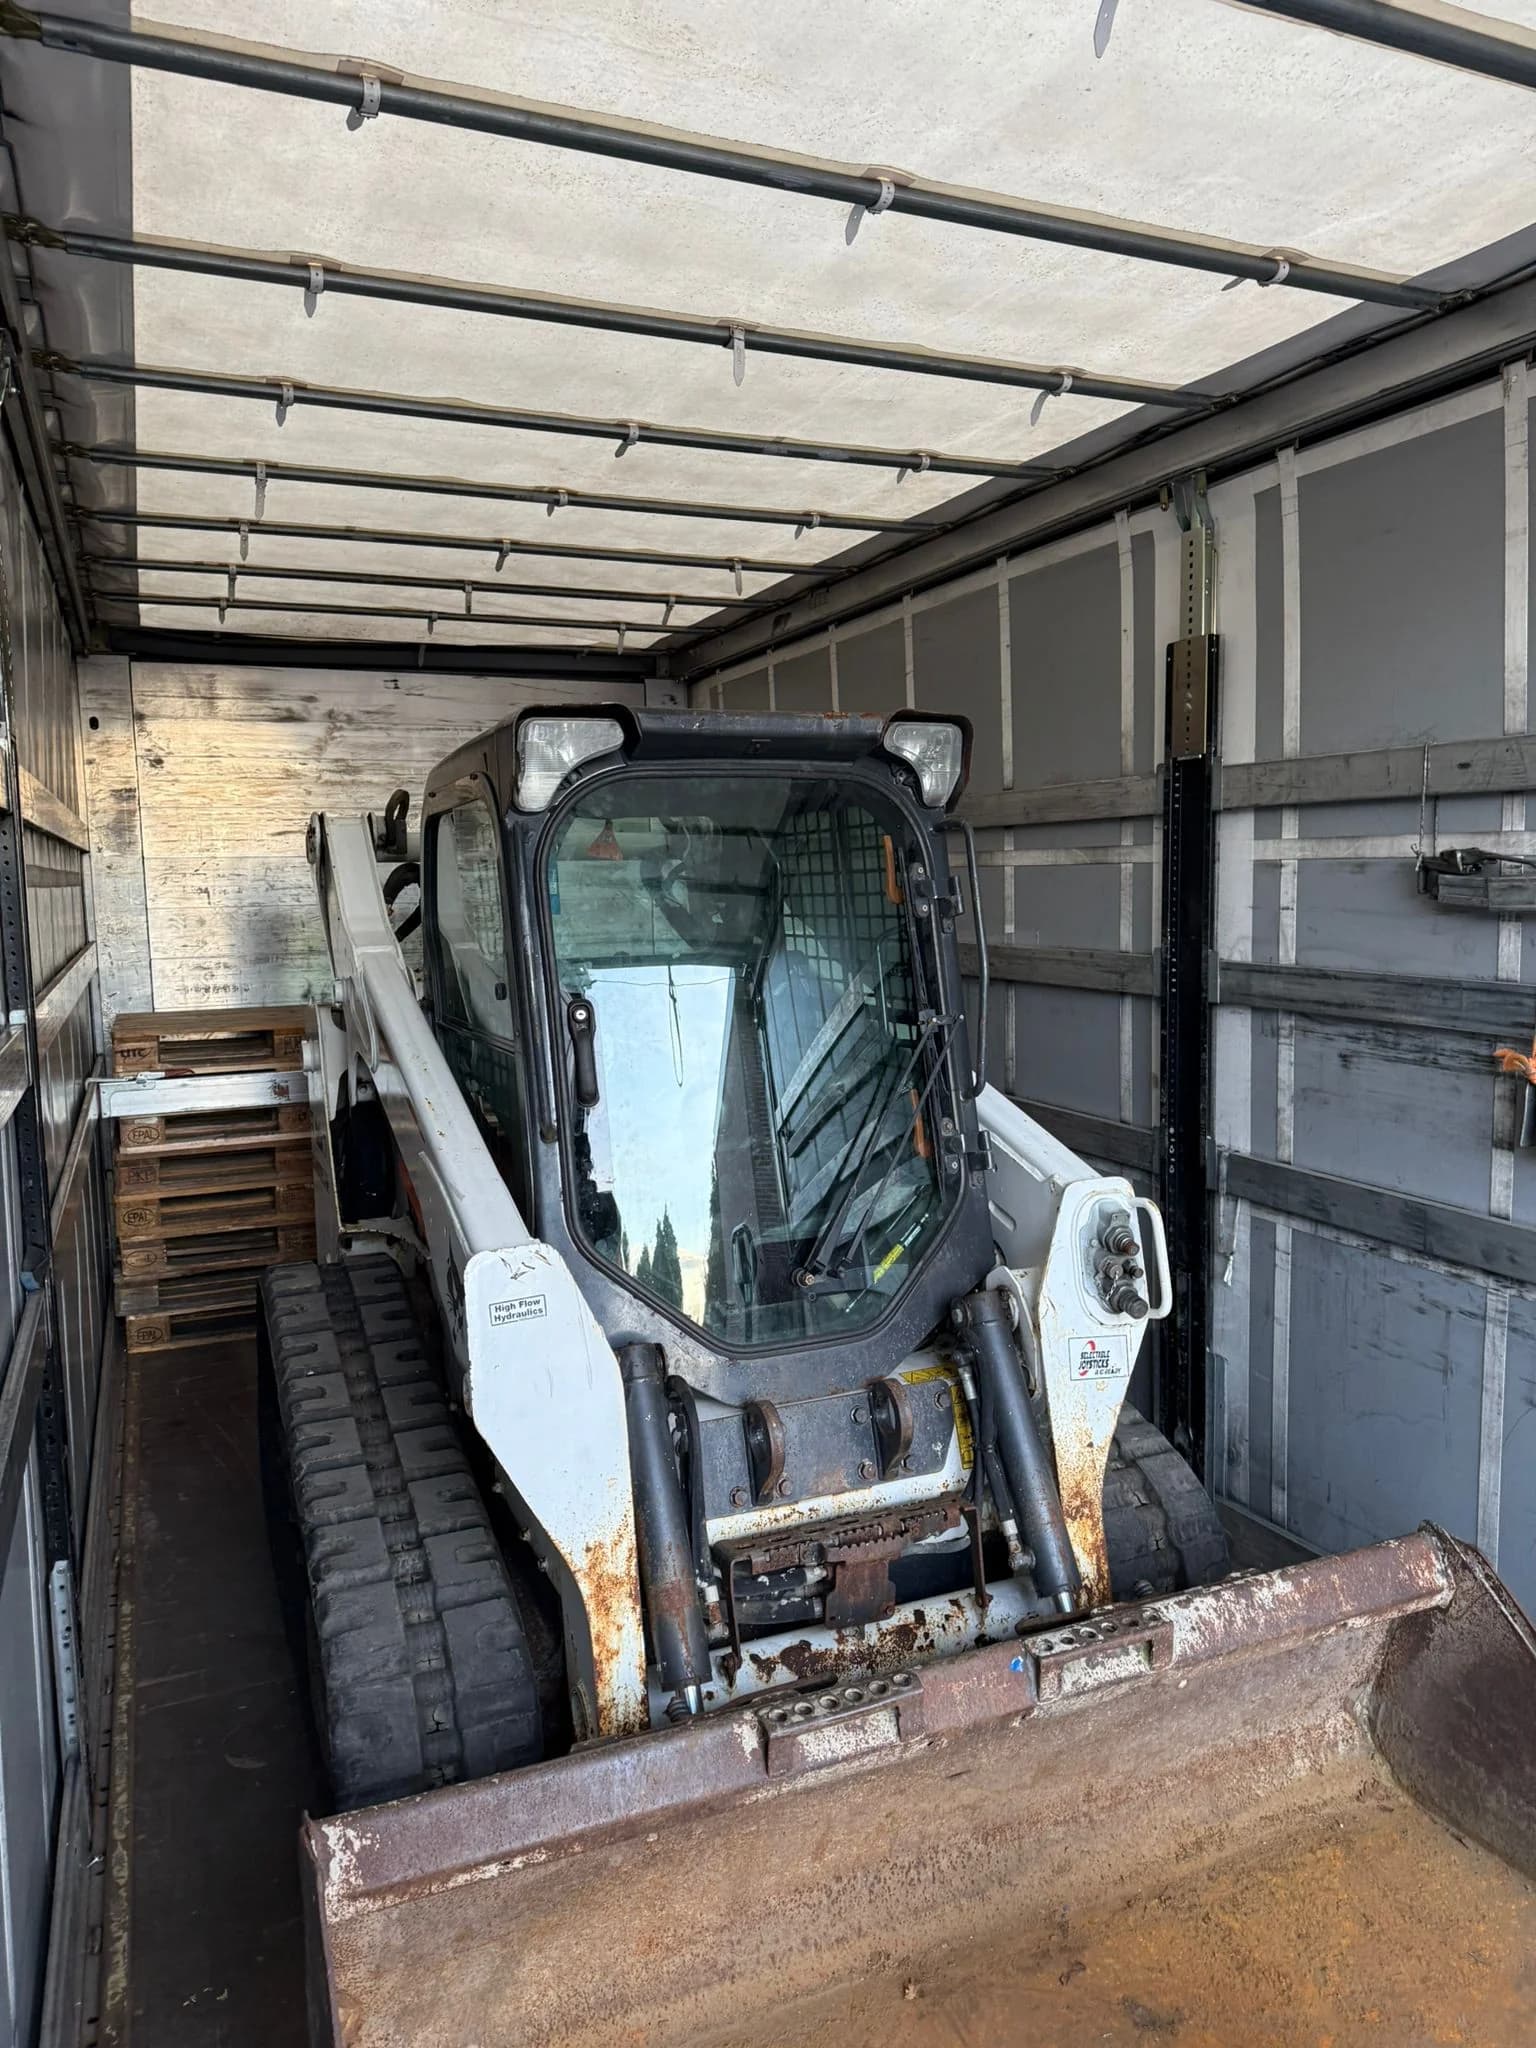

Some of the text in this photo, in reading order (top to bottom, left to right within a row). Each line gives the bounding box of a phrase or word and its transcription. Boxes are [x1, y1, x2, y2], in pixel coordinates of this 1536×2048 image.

[127, 1211, 149, 1223] EPAL
[494, 1299, 541, 1313] High Flow
[494, 1308, 543, 1322] Hydraulics
[1079, 1359, 1109, 1369] JOYSTICKS
